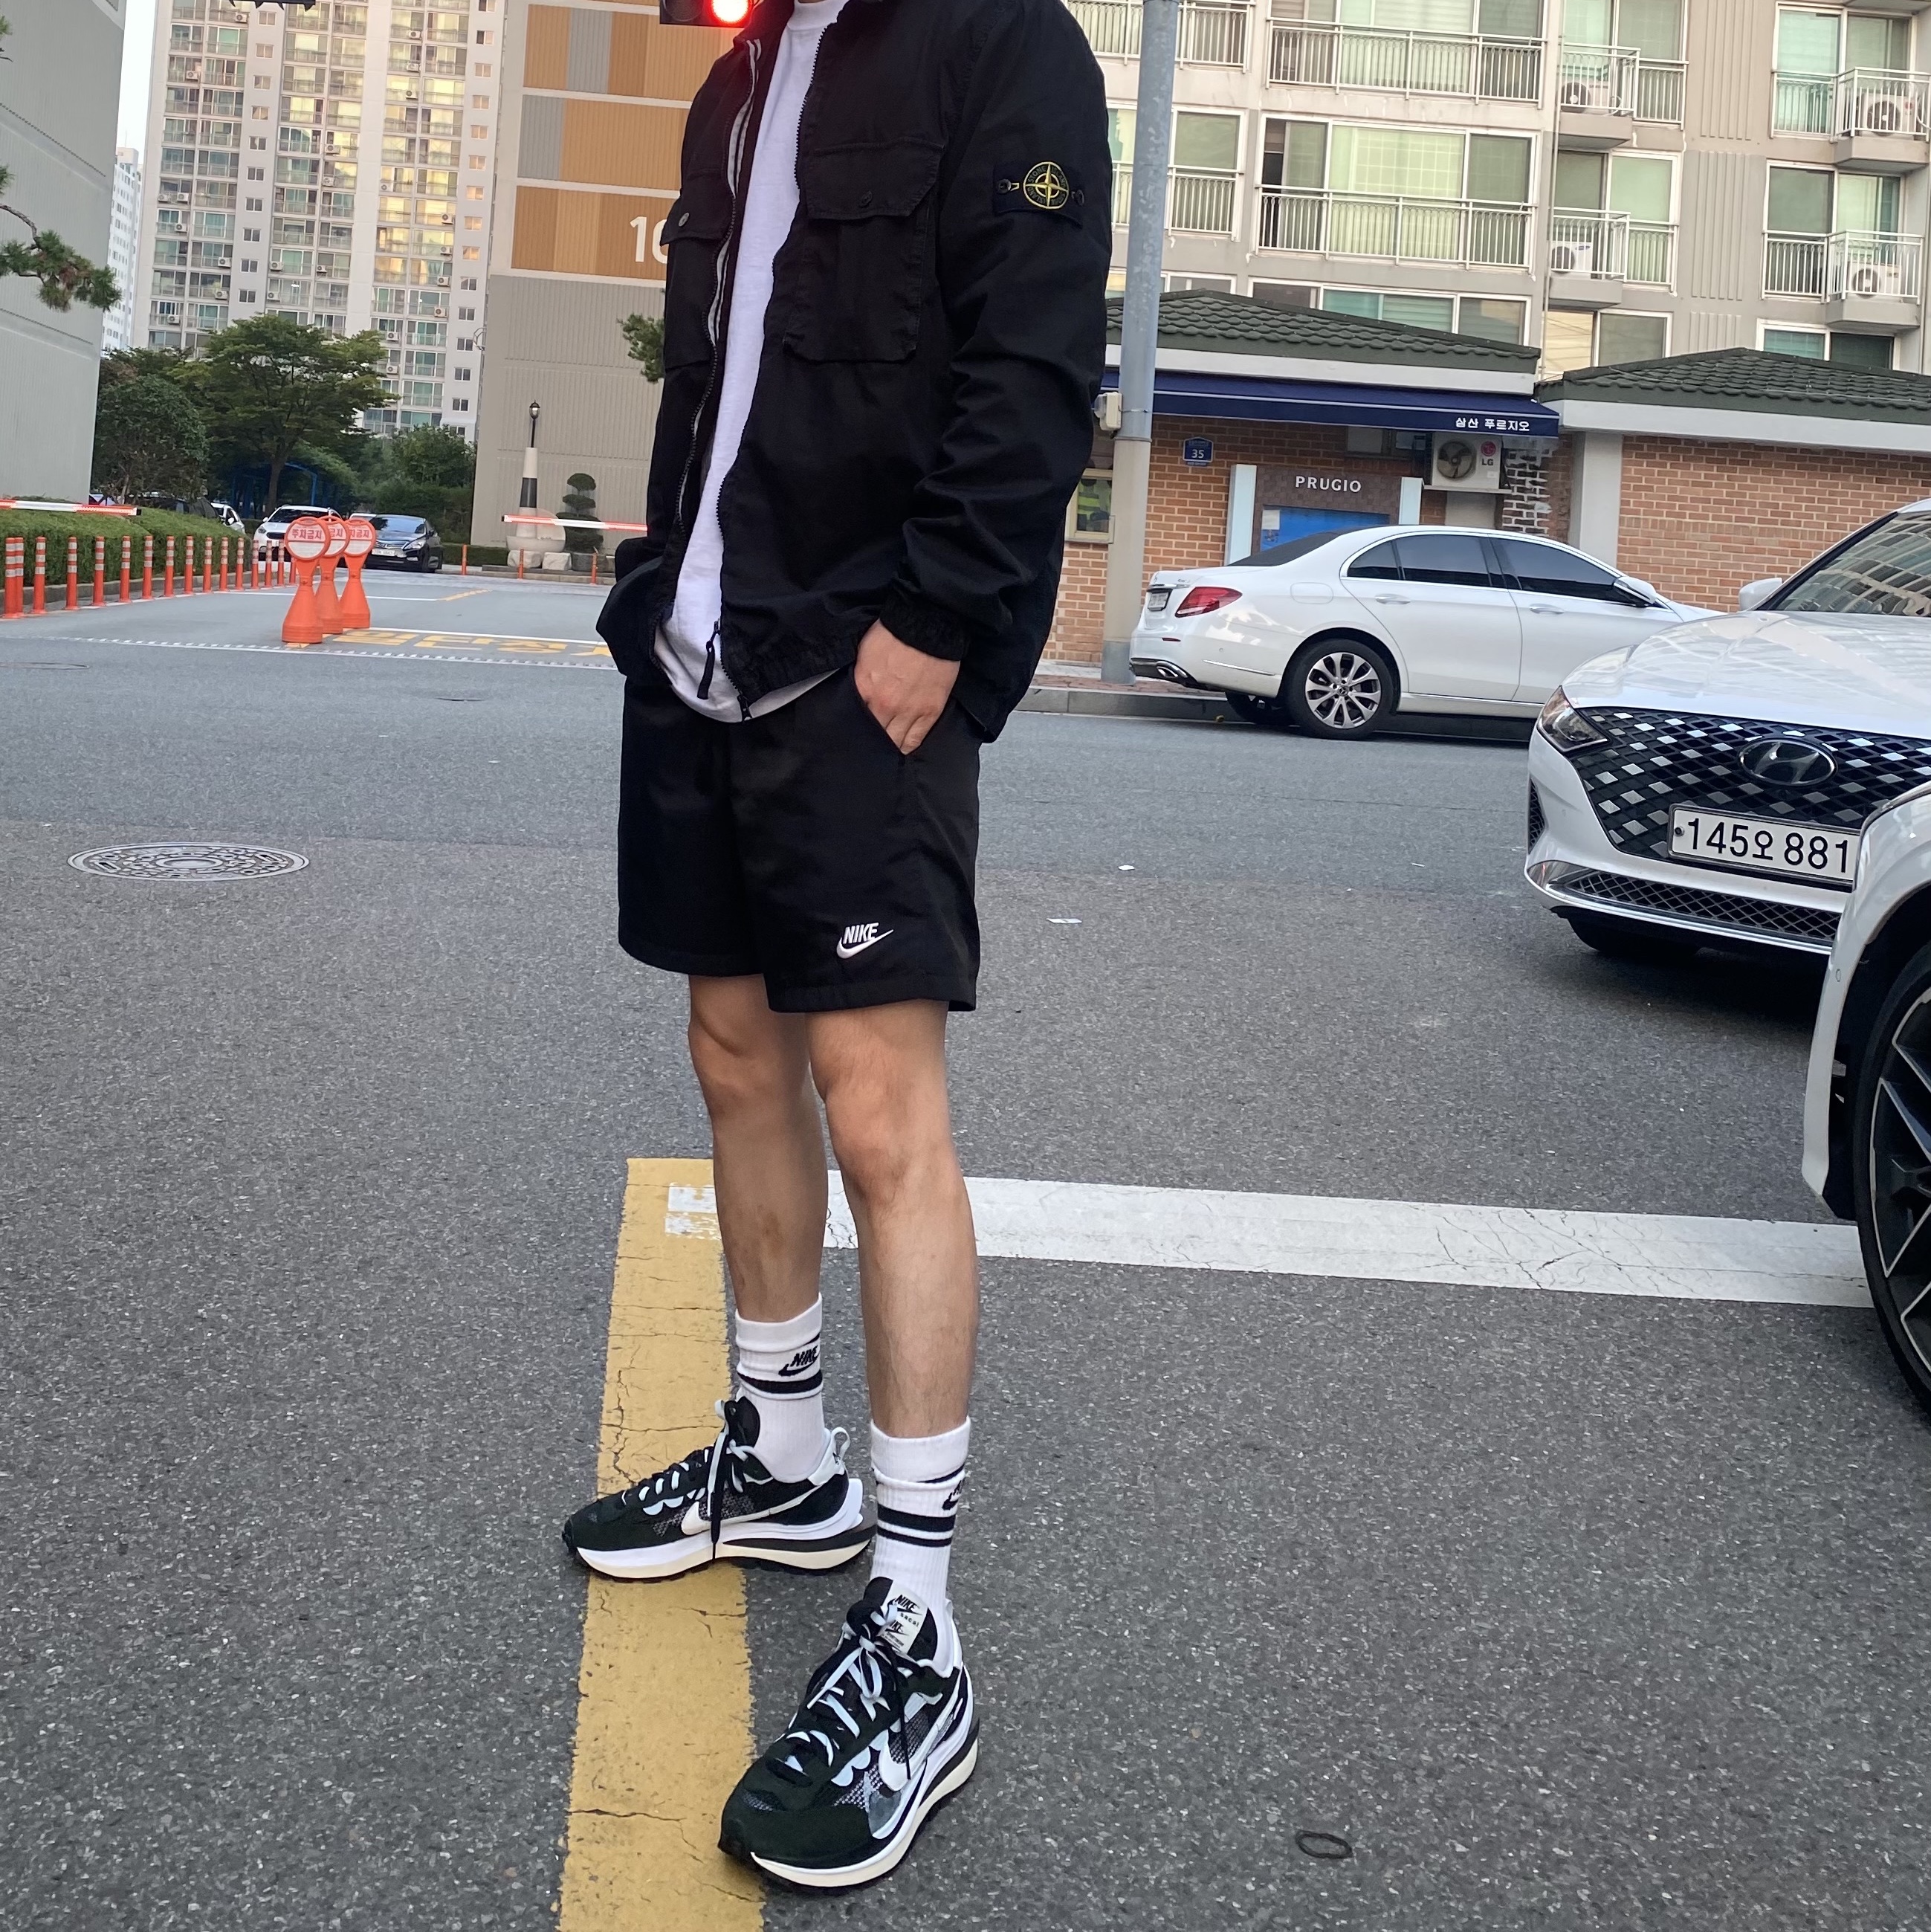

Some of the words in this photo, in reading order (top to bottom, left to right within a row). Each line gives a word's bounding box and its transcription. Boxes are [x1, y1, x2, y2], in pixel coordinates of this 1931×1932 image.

[1456, 417, 1478, 428] 삼산
[1485, 419, 1530, 431] 푸르지오
[1191, 449, 1204, 459] 35
[1482, 458, 1493, 466] LG
[1296, 476, 1362, 492] PRUGIO
[292, 529, 322, 540] 주차금지
[1688, 818, 1773, 861] 145오
[1784, 832, 1848, 873] 881
[843, 923, 879, 944] NIKE
[894, 1595, 920, 1611] NIKE
